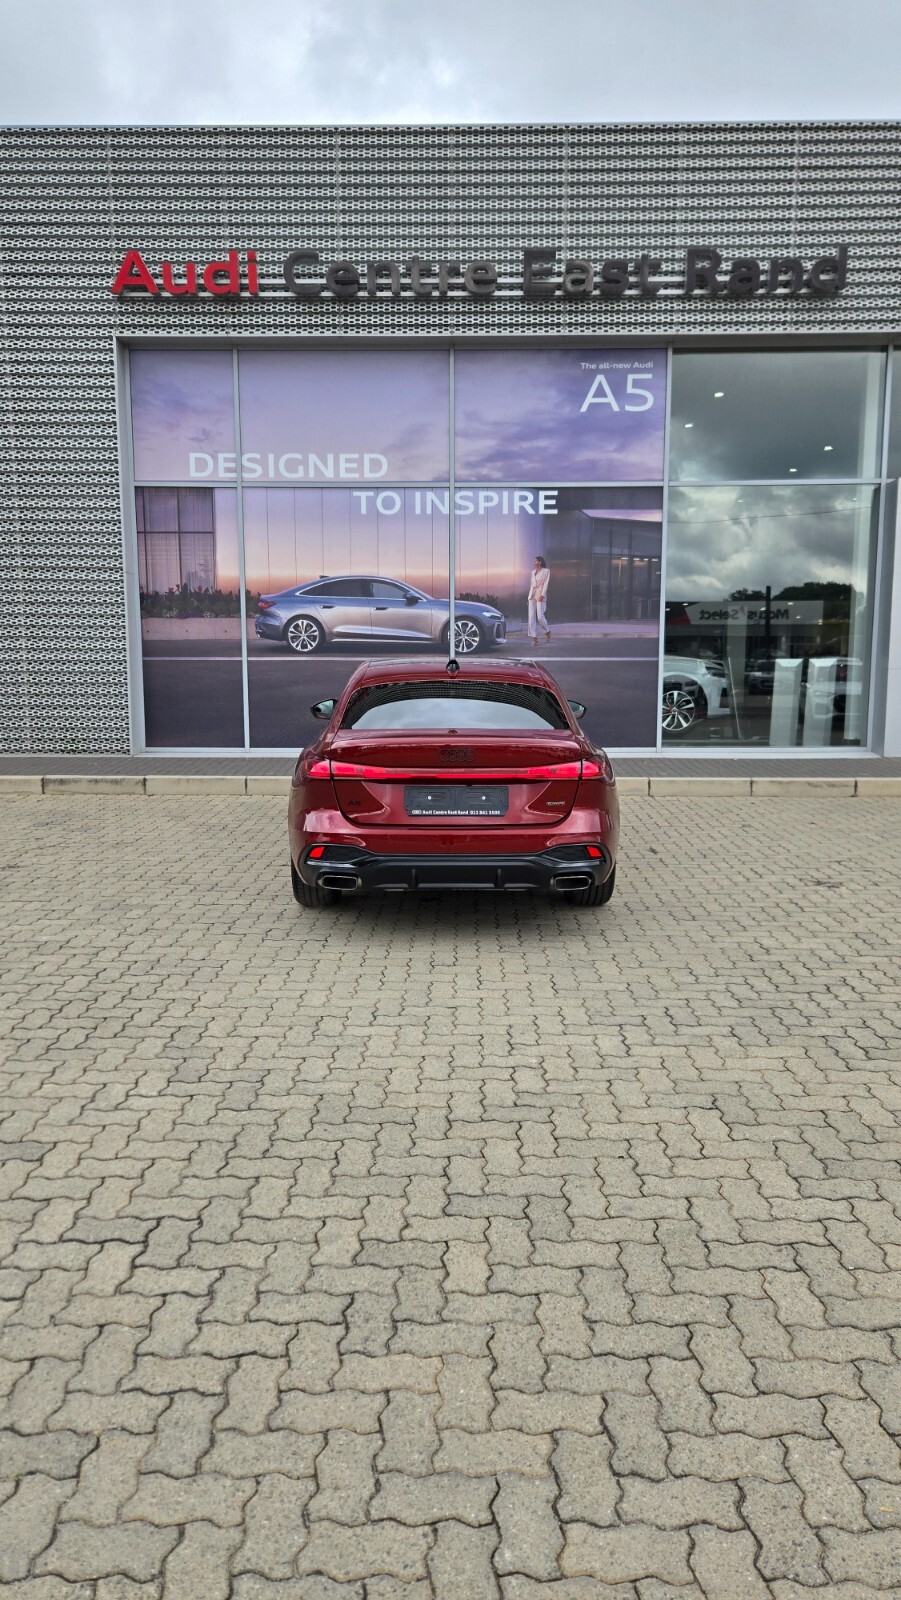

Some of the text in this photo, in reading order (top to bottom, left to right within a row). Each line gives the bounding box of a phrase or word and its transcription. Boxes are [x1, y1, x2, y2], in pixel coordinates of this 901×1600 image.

[111, 246, 849, 298] Audi Centre East Rand
[580, 361, 653, 370] The all-new Audi
[579, 373, 655, 413] A5
[188, 452, 389, 479] DESIGNED
[352, 490, 559, 515] TO INSPIRE
